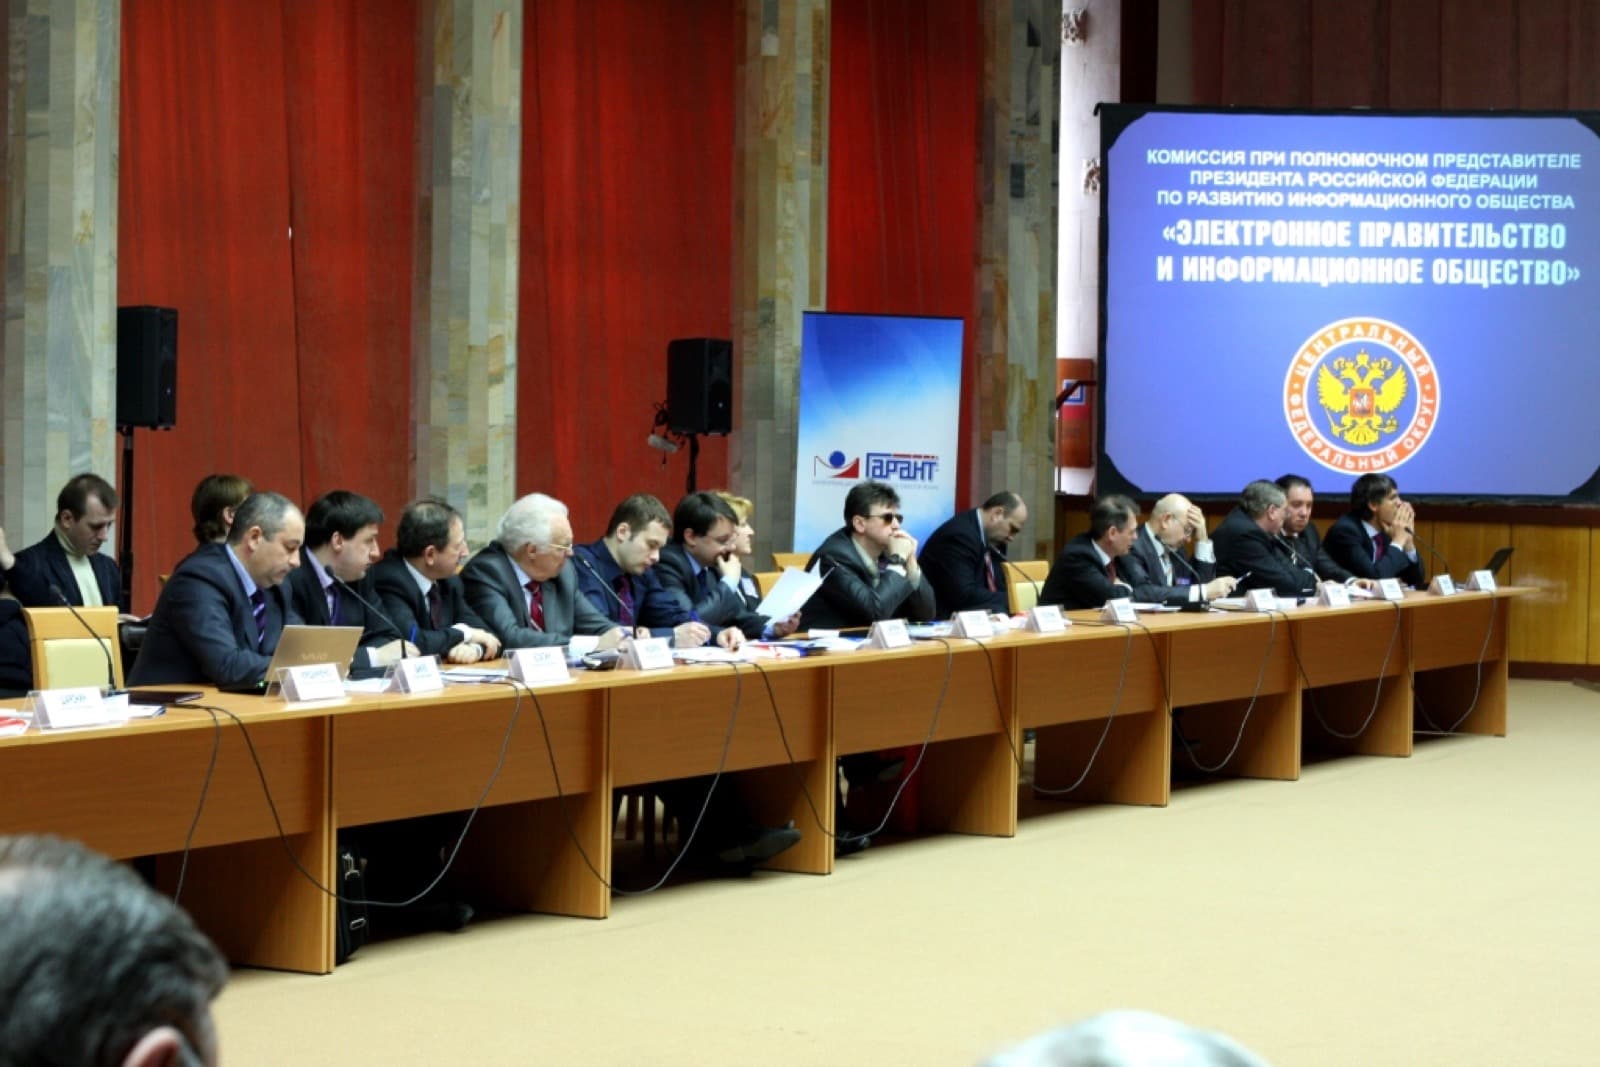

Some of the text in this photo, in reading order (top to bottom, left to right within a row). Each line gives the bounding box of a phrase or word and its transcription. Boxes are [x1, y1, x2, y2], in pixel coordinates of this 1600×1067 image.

[1147, 149, 1581, 170] КОМИССИЯ ПРИ ПОЛНОМОЧНОМ ПРЕДСТАВИТЕЛЕ
[1190, 170, 1538, 190] ПРЕЗИДЕНТА РОССИЙСКОЙ ФЕДЕРАЦИИ
[1157, 191, 1575, 211] ПО РАЗВИТИЮ ИНФОРМАЦИОННОГО ОБЩЕСТВА
[1163, 219, 1566, 248] «ЭЛЕКТРОННОЕ ПРАВИТЕЛЬСТВО
[1157, 256, 1580, 288] И ИНФОРМАЦИОННОЕ ОБЩЕСТВО»
[1295, 322, 1431, 376] ЦЕНТРАЛЬНЫЙ
[1290, 393, 1434, 470] ФЕДЕРАЛЬНЫЙ ОКРУГ
